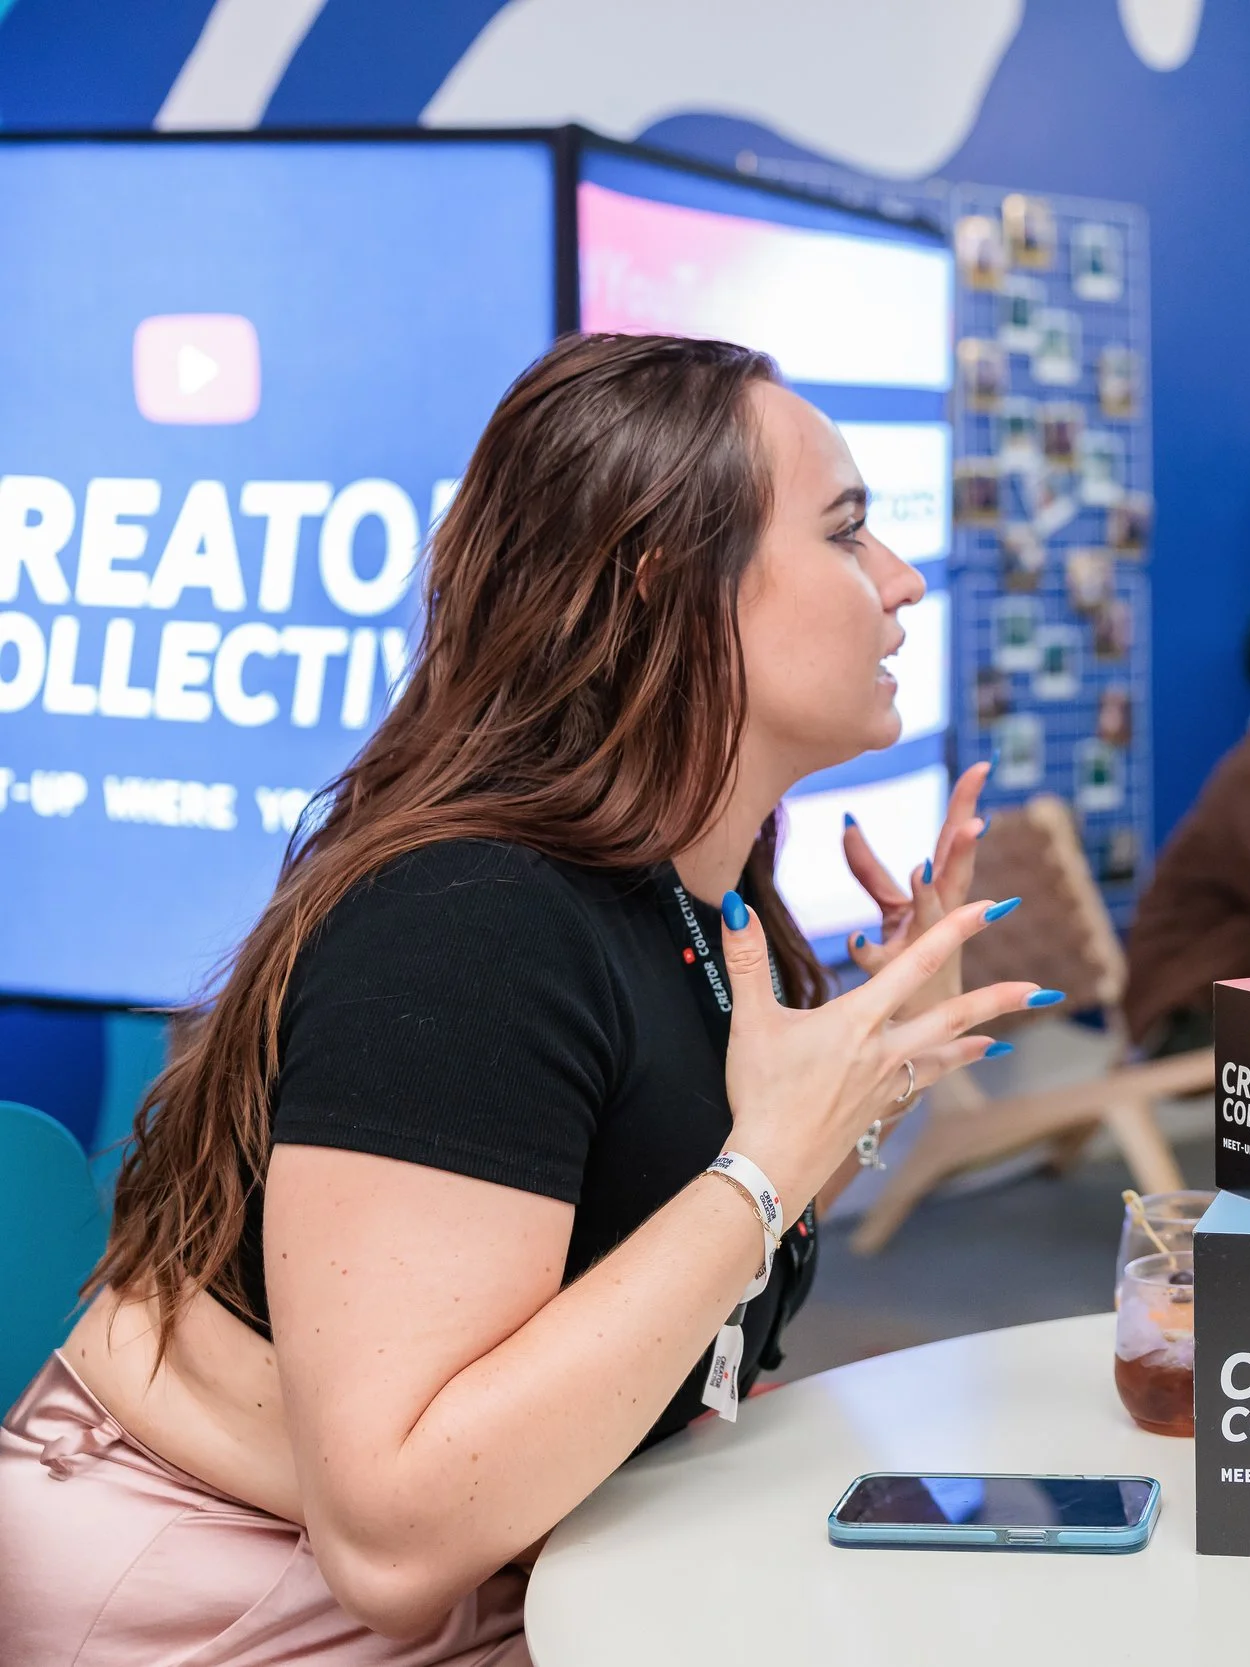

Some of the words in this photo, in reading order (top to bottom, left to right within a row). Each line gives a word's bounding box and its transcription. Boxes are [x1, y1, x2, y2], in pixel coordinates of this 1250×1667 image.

[103, 775, 237, 831] WHERE
[673, 885, 710, 957] COLLECTIVE
[703, 960, 732, 1013] CREATOR
[762, 1190, 777, 1220] CREATOR
